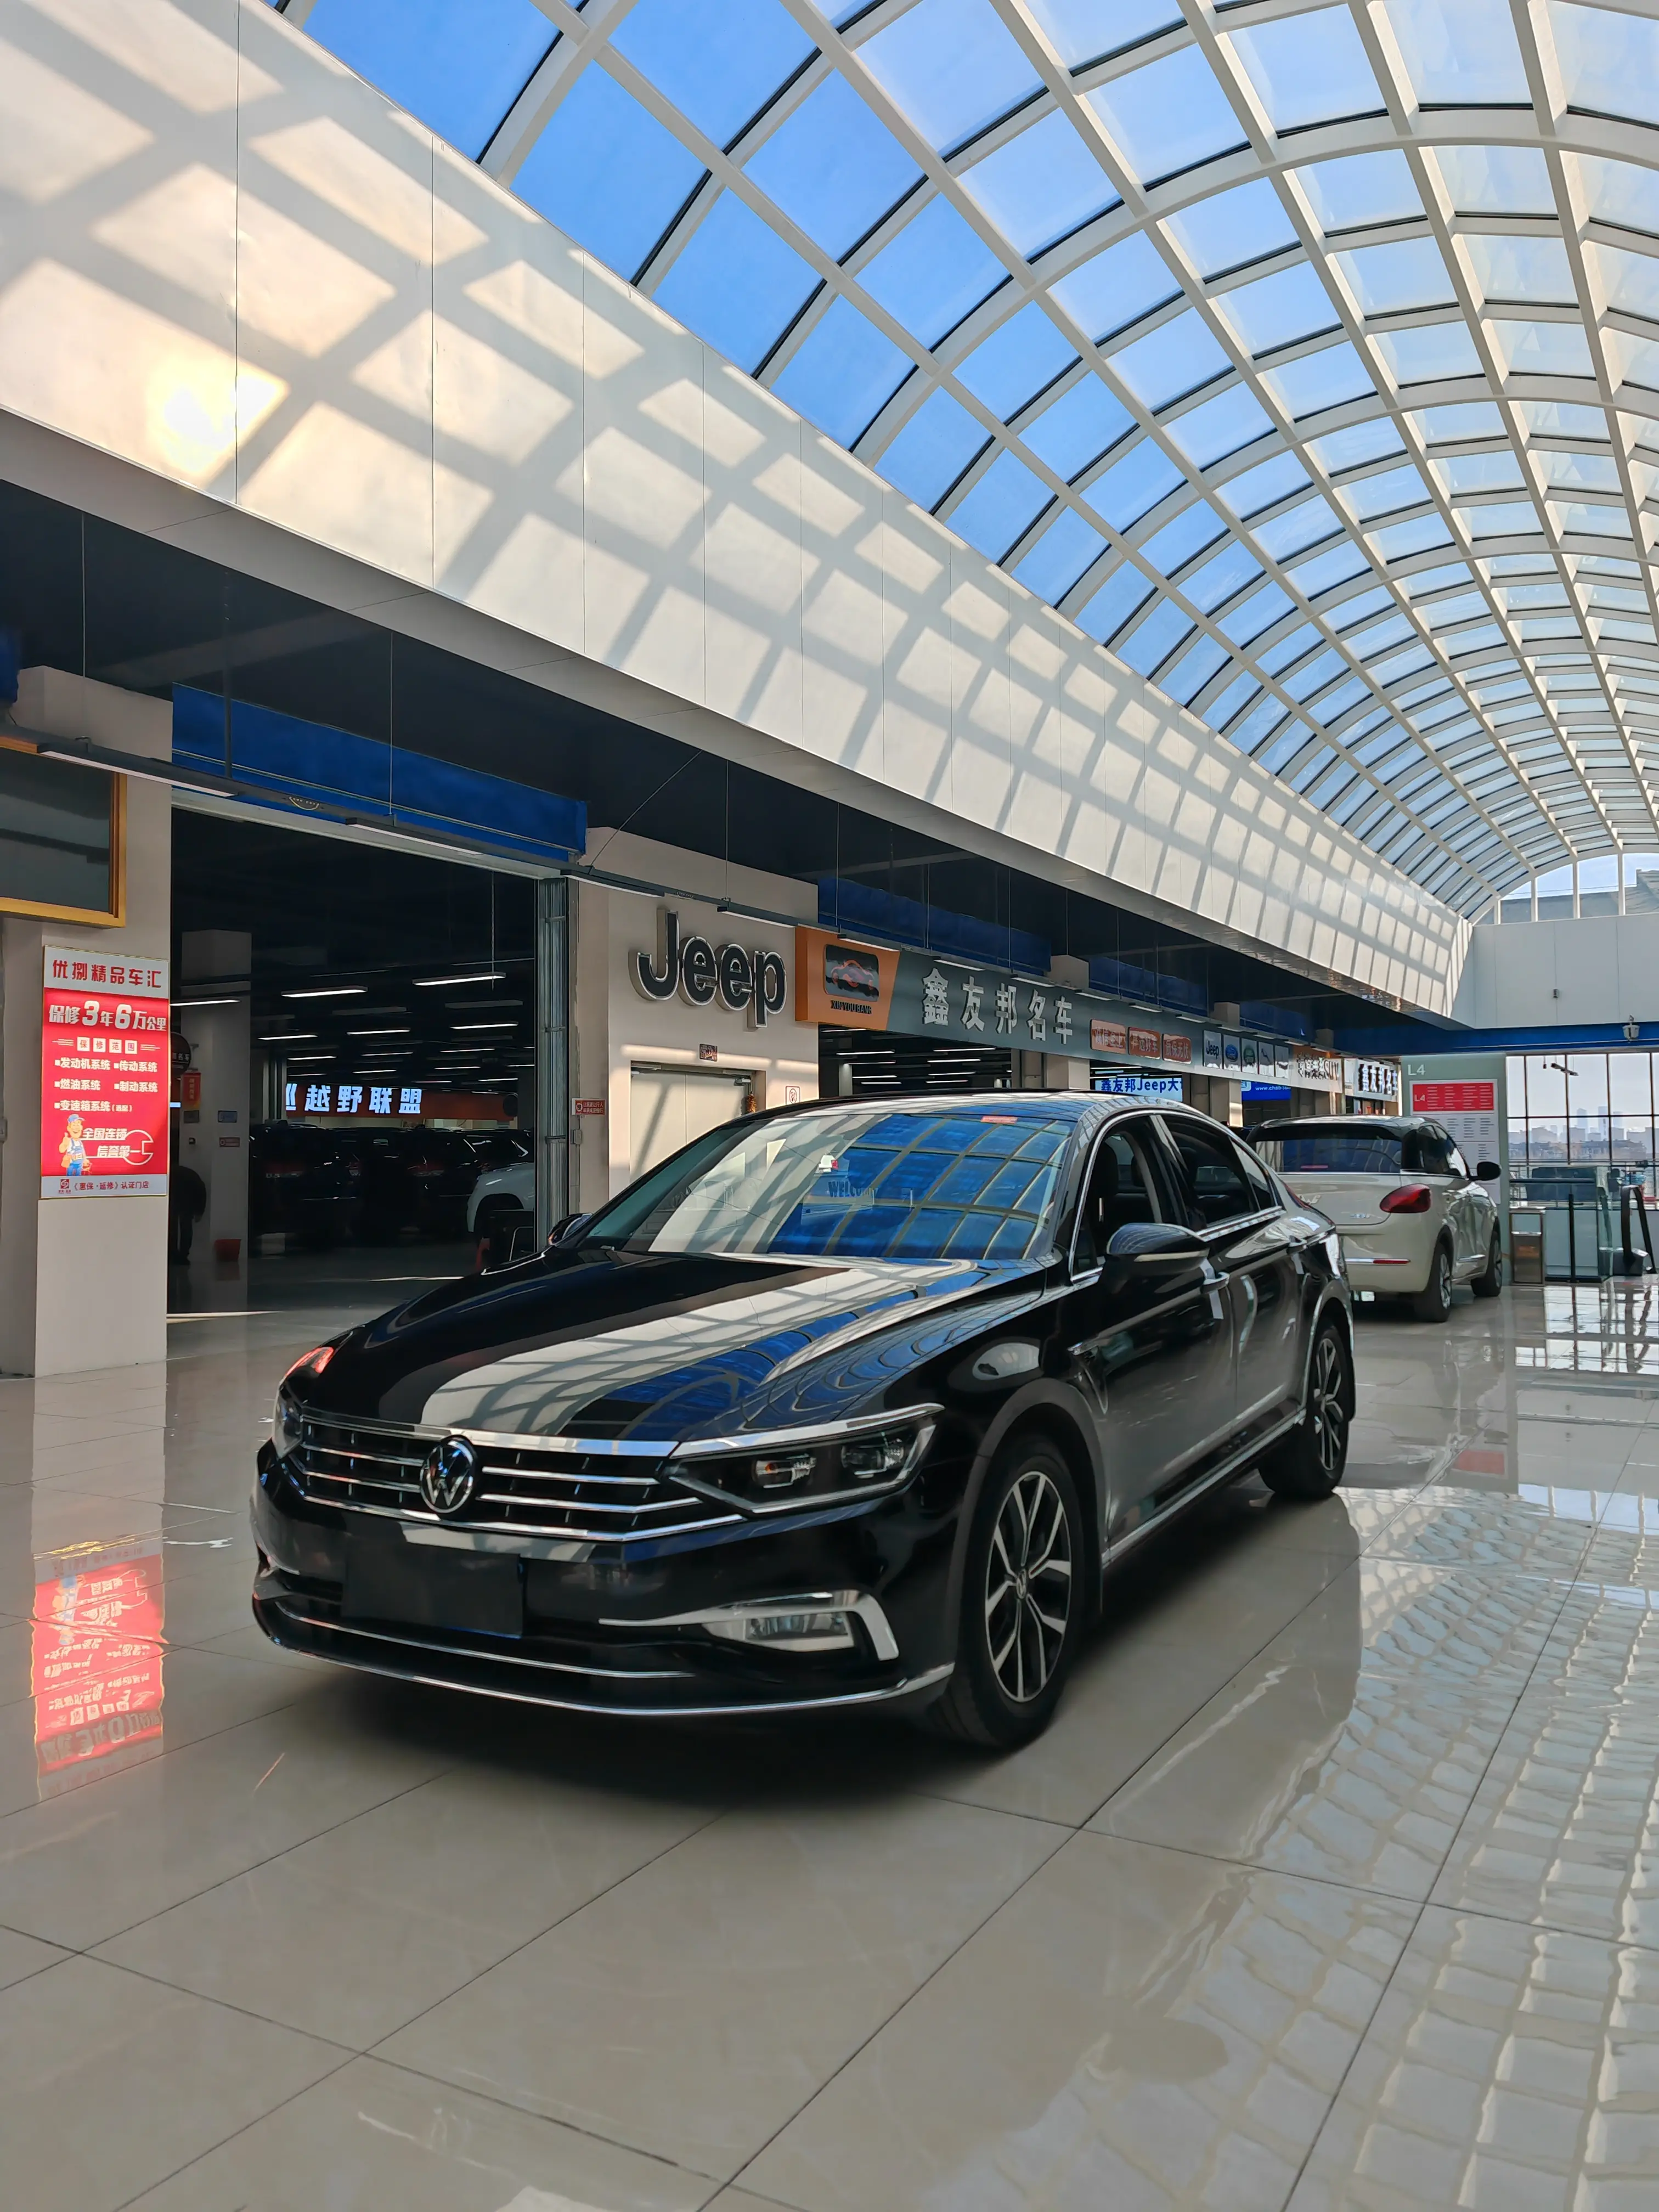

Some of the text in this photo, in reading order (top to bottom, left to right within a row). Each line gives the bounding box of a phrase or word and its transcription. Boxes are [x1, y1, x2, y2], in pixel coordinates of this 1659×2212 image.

[52, 959, 162, 988] 优捌精品车汇
[629, 907, 787, 1031] Jeep
[831, 1000, 872, 1015] XIN YOU BANG
[921, 967, 1073, 1045] 鑫友邦名车
[48, 1000, 167, 1031] 保修3年6万公里
[78, 1039, 136, 1053] 保修范围
[1206, 1040, 1220, 1059] Jeep
[60, 1057, 111, 1070] 发动机系统
[119, 1060, 158, 1073] 传动系统
[1407, 1064, 1425, 1076] L4
[60, 1078, 101, 1091] 燃油系统
[119, 1081, 158, 1092] 制动系统
[1101, 1078, 1182, 1093] 鑫友邦Jeep大
[82, 1127, 127, 1139] 全国连锁
[97, 1145, 141, 1157] 信誉第一
